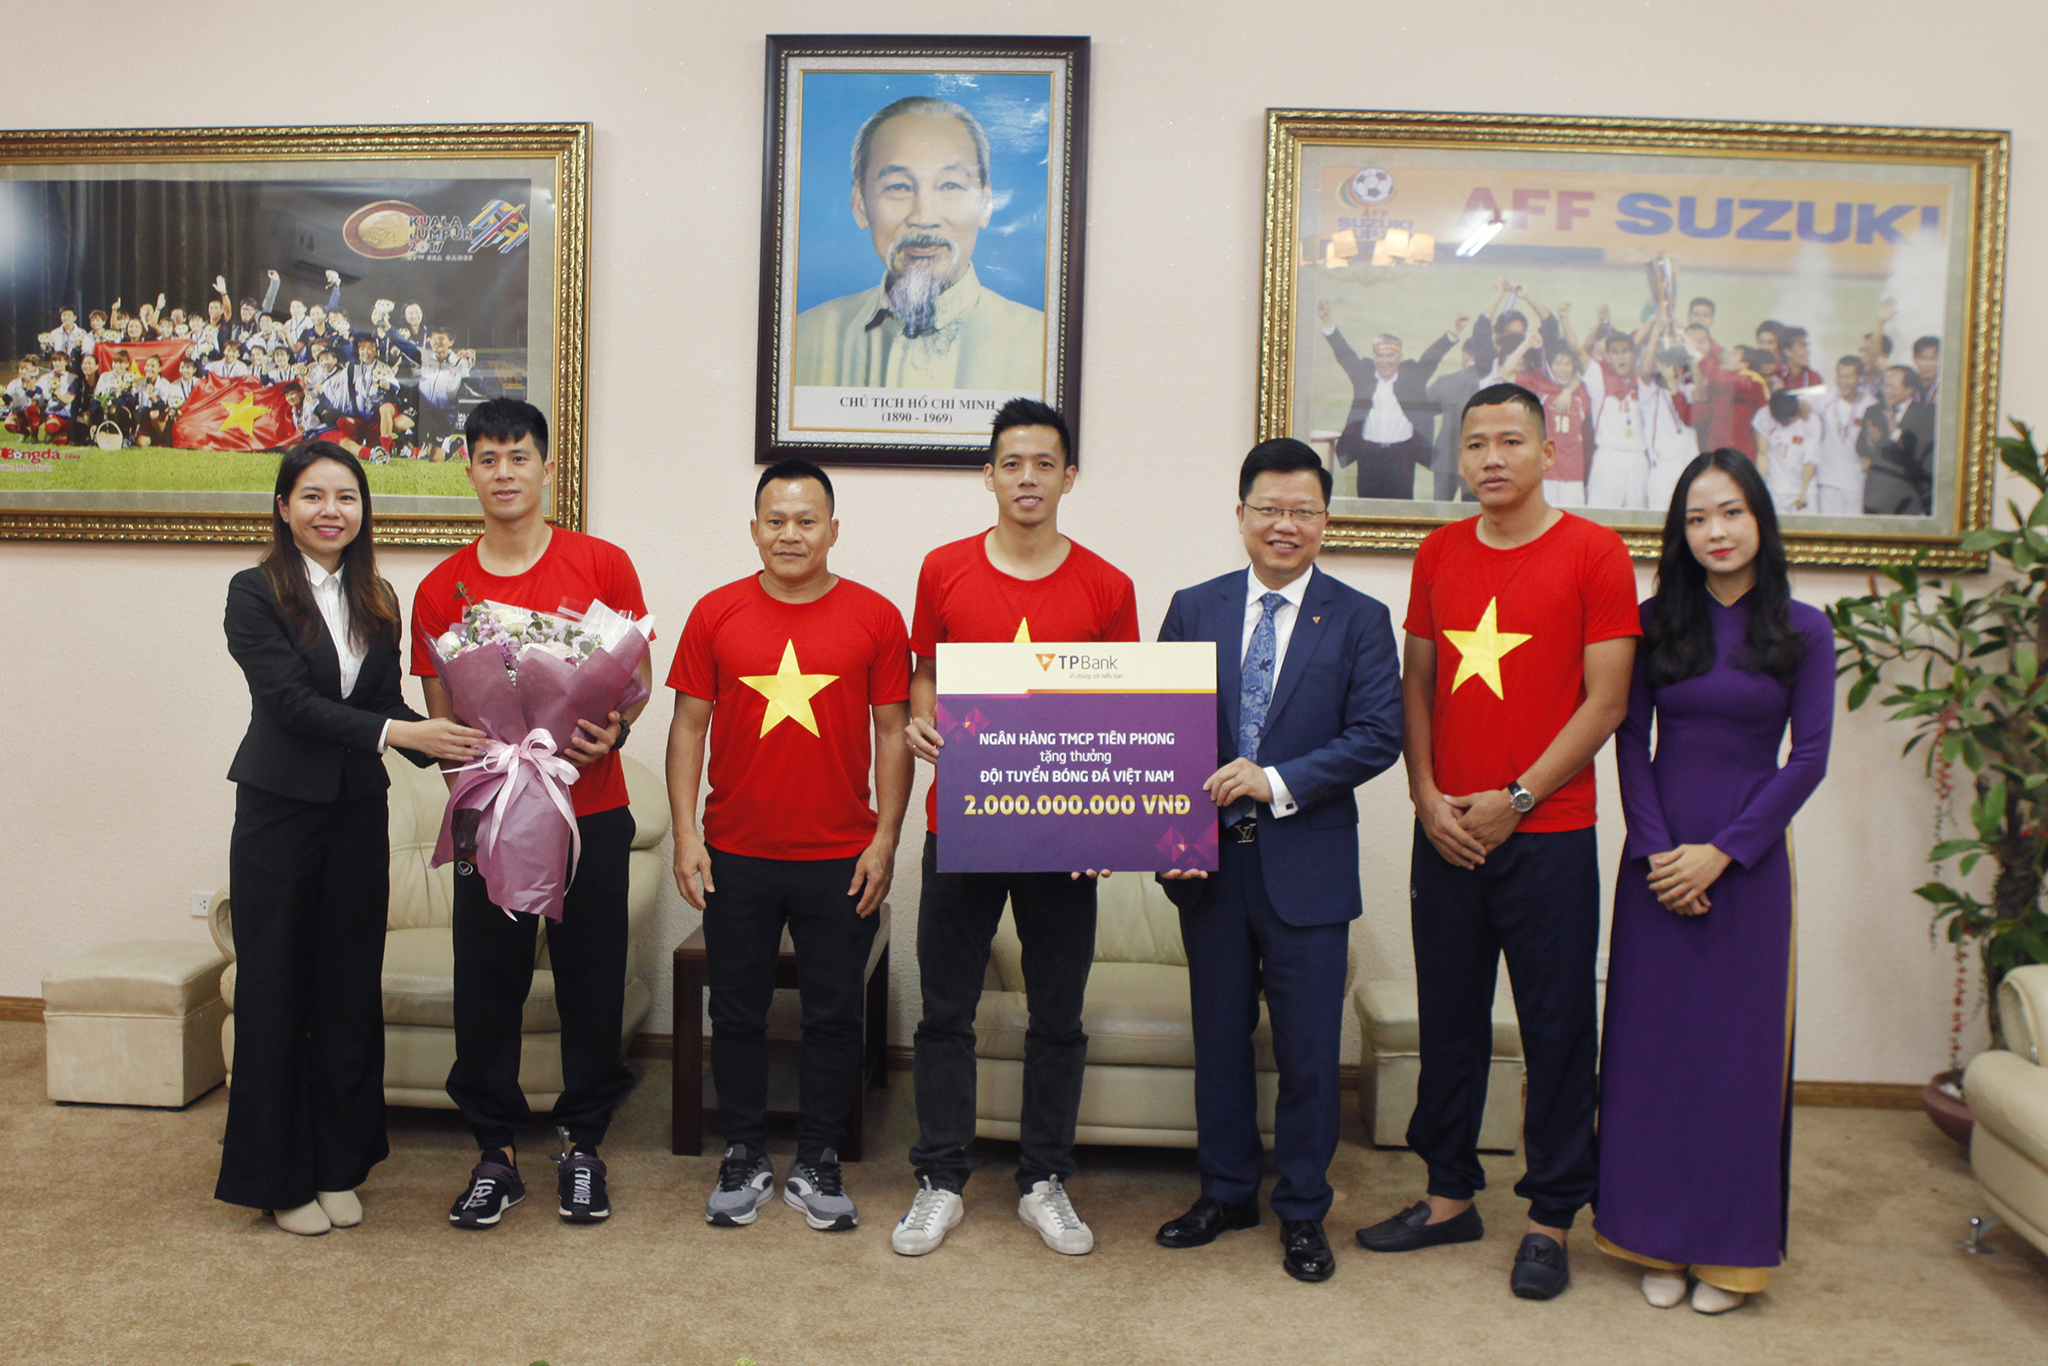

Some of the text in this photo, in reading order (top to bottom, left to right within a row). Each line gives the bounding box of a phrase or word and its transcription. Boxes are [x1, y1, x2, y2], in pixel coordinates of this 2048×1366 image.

[409, 215, 463, 227] KUALA
[1338, 217, 1413, 229] SUZUKI
[1458, 187, 1940, 246] AFF SUZUKI
[409, 228, 473, 241] LUMPUR
[408, 240, 444, 253] 2017
[840, 394, 995, 411] CHỦ TỊCH HỒ CHÍ MINH
[882, 412, 912, 423] (1890
[923, 413, 953, 424] 1969)
[979, 730, 1175, 745] NGÂN HÀNG TMCP TIÊN PHONG
[1040, 750, 1112, 765] tặng thưởng
[980, 765, 1174, 785] ĐỘI TUYỂN BÓNG ĐÁ VIỆT NAM
[964, 794, 1191, 815] 2.000.000.000 VNĐ
